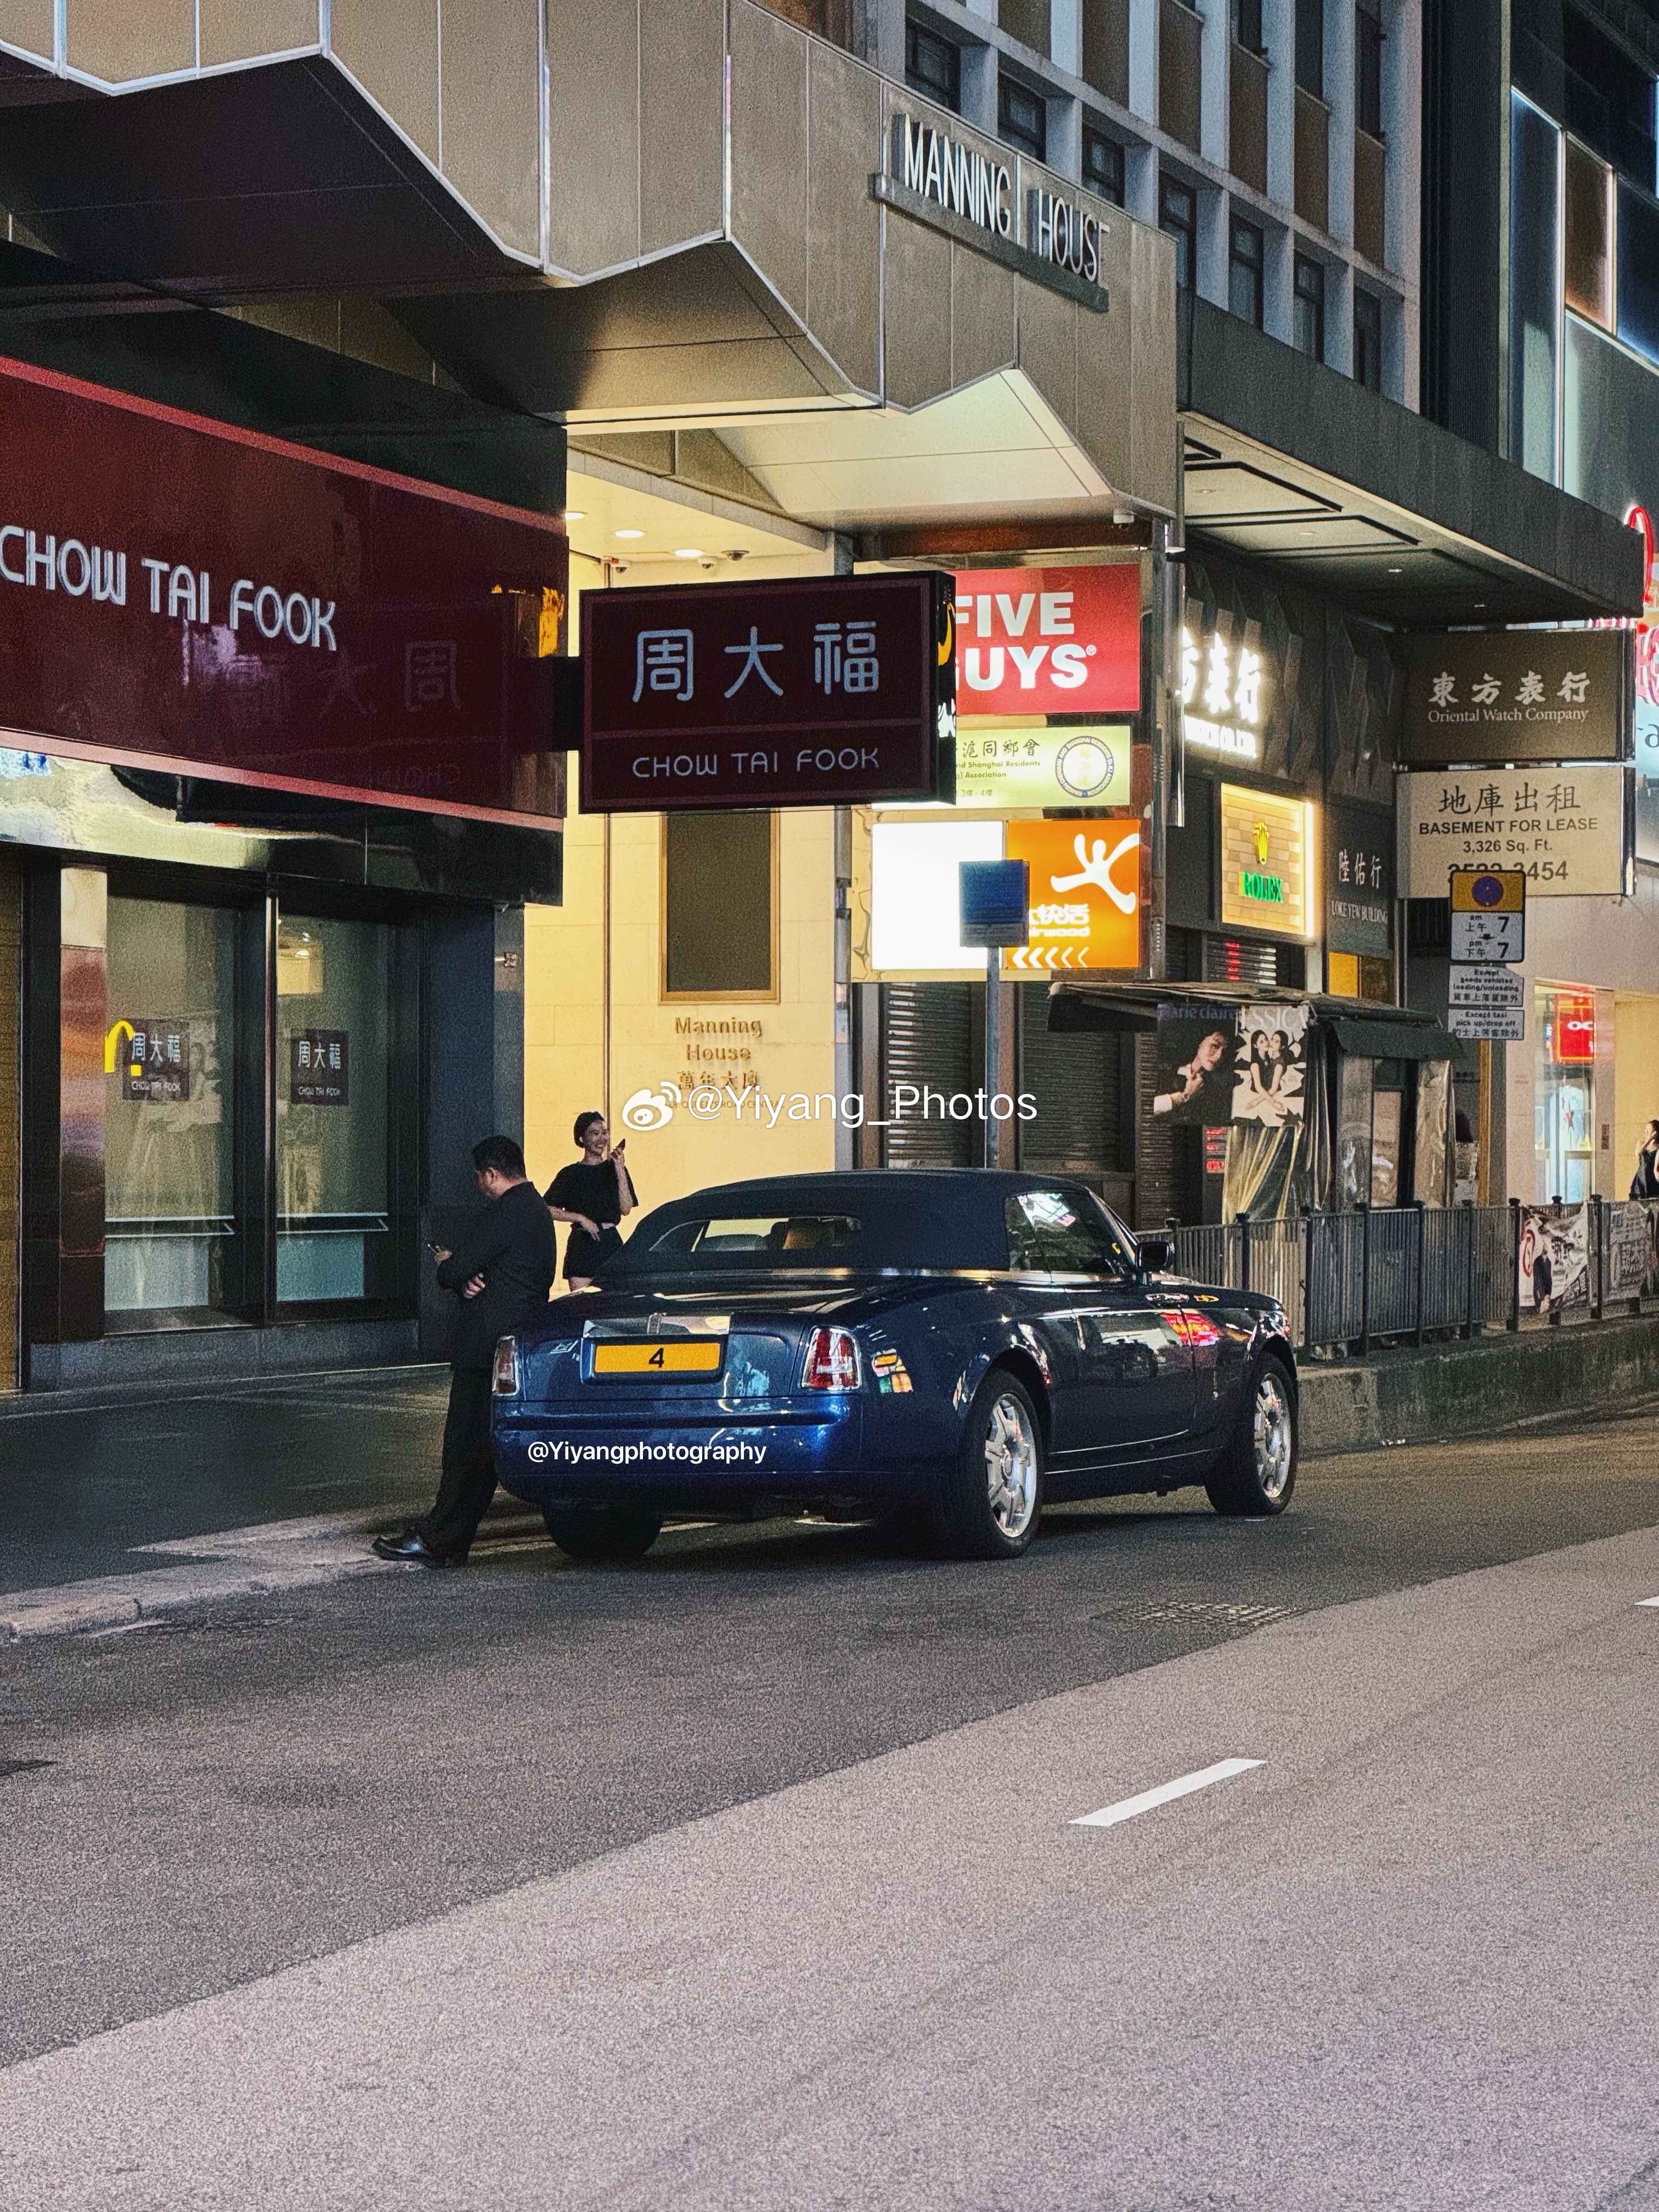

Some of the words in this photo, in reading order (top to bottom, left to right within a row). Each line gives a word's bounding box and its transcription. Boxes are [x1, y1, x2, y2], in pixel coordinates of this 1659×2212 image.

[905, 113, 1011, 237] MANNING
[0, 525, 126, 606] CHOW
[142, 558, 210, 624] TAI
[229, 579, 337, 651] FOOK
[633, 620, 879, 703] 周大福
[956, 643, 1088, 691] UYS
[1428, 670, 1590, 707] 東方表行
[1427, 708, 1480, 723] Oriental
[1483, 707, 1522, 722] Watch
[1526, 708, 1589, 724] Company
[956, 738, 1040, 758] 滬同鄉會
[633, 753, 718, 778] CHOW
[731, 751, 778, 775] TAI
[797, 747, 879, 772] FOOK
[1438, 782, 1582, 817] 地庫出租
[1419, 821, 1504, 835] BASEMENT
[1509, 820, 1541, 832] FOR
[1547, 818, 1599, 831] LEASE
[1463, 840, 1502, 853] 3,326
[1506, 840, 1530, 854] Sq.
[1534, 839, 1553, 851] Ft.
[1339, 848, 1382, 889] 陸佑行
[1240, 871, 1284, 904] ROLEX
[1361, 905, 1388, 925] BUILDING
[1498, 916, 1509, 933] 7
[1465, 923, 1487, 932] 上午
[1466, 948, 1486, 958] 下午
[1498, 942, 1509, 958] 7
[675, 1017, 763, 1038] Manning
[132, 1032, 180, 1063] 周大福
[298, 1041, 341, 1069] 周大福
[686, 1044, 752, 1061] House
[648, 1348, 665, 1368] 4
